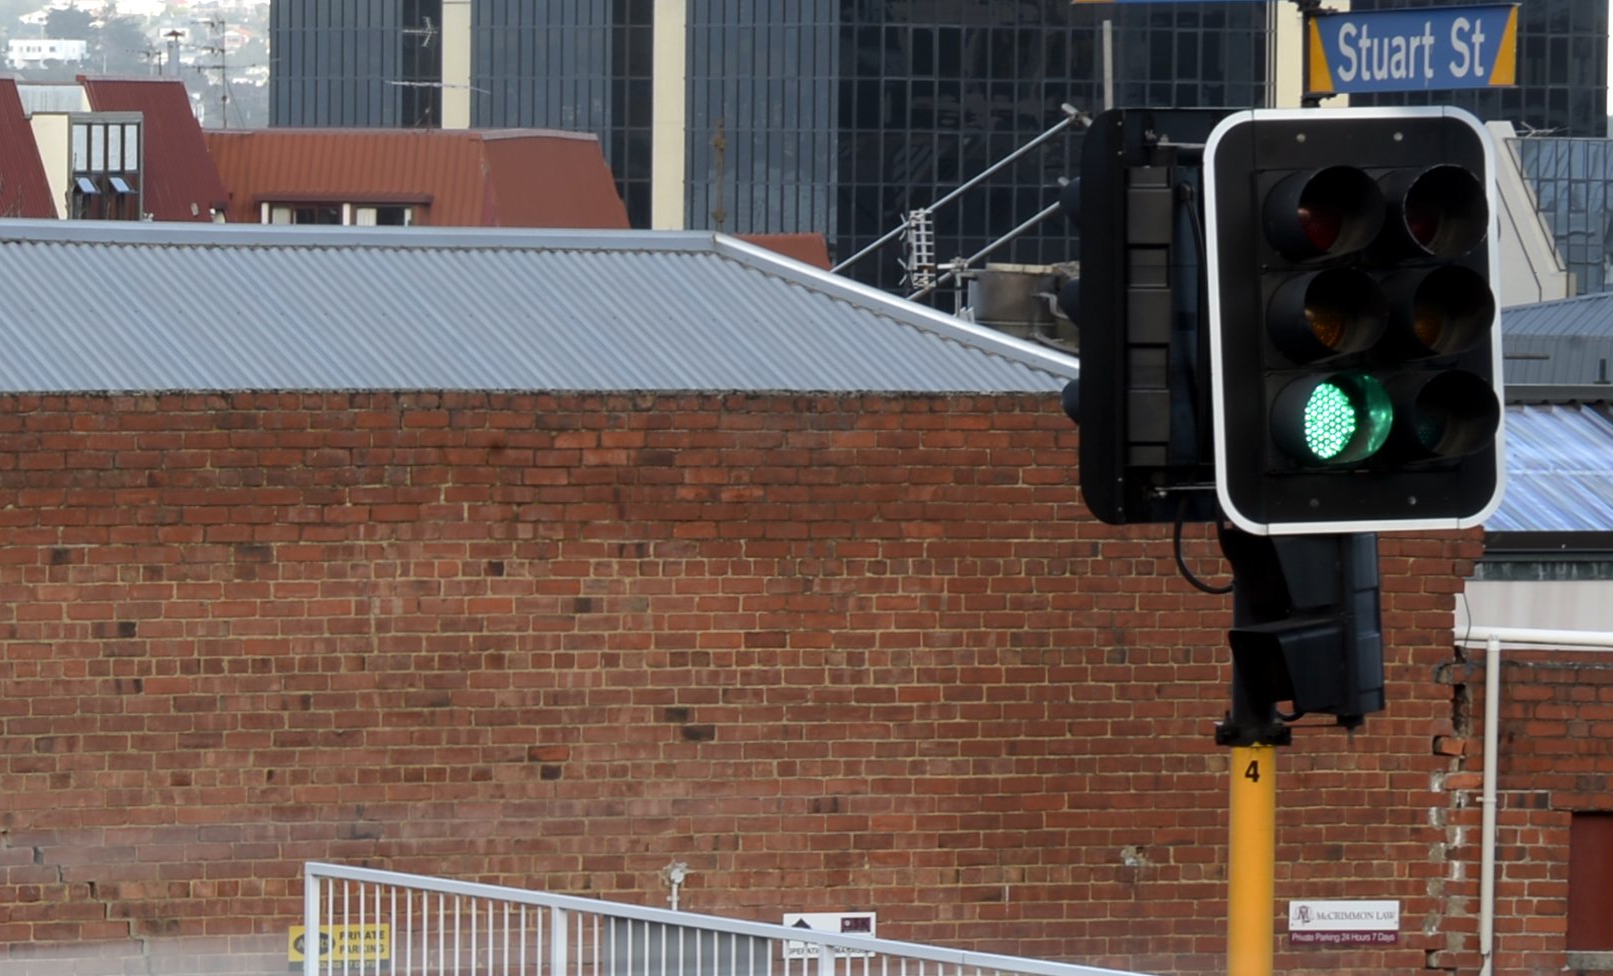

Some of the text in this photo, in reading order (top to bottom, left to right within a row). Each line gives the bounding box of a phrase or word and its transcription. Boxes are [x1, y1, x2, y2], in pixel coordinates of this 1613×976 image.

[1337, 16, 1486, 82] Stuart St
[1245, 760, 1260, 783] 4
